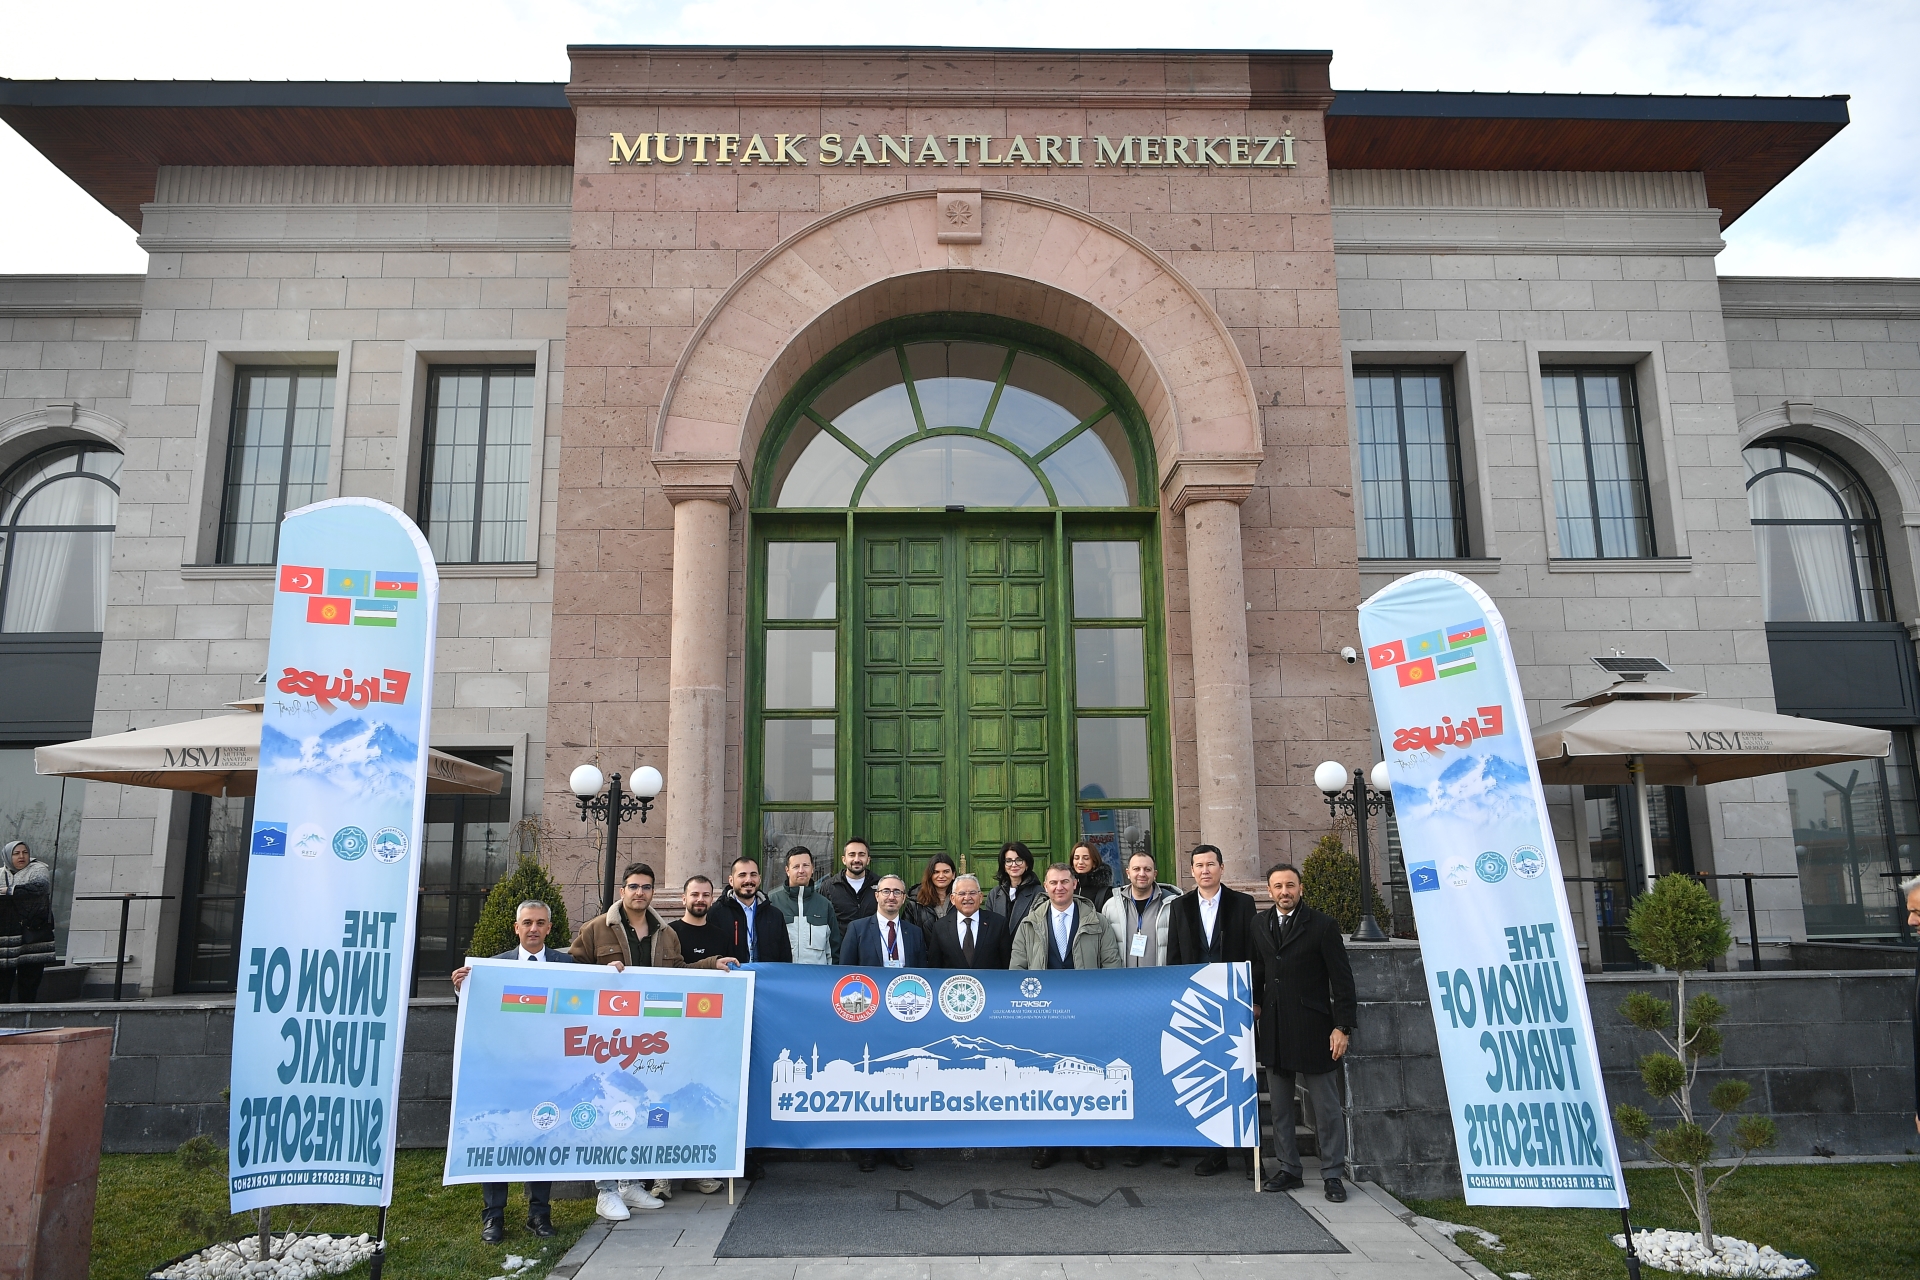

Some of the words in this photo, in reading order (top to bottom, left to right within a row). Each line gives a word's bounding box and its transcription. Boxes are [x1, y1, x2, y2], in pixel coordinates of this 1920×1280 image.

[608, 132, 808, 166] MUTFAK
[819, 133, 1084, 167] SANATLARI
[1094, 129, 1297, 168] MERKEZİ
[1685, 731, 1744, 751] MSM
[161, 747, 221, 768] MSM
[564, 1025, 670, 1071] Erciyes
[777, 1090, 1127, 1116] #2027KulturBaskentiKayseri
[466, 1147, 495, 1167] THE
[496, 1146, 547, 1166] UNION
[548, 1146, 571, 1166] OF
[575, 1145, 627, 1165] TURKIC
[630, 1145, 653, 1164] SKI
[654, 1144, 717, 1164] RESORTS
[886, 1186, 1156, 1212] MSM
